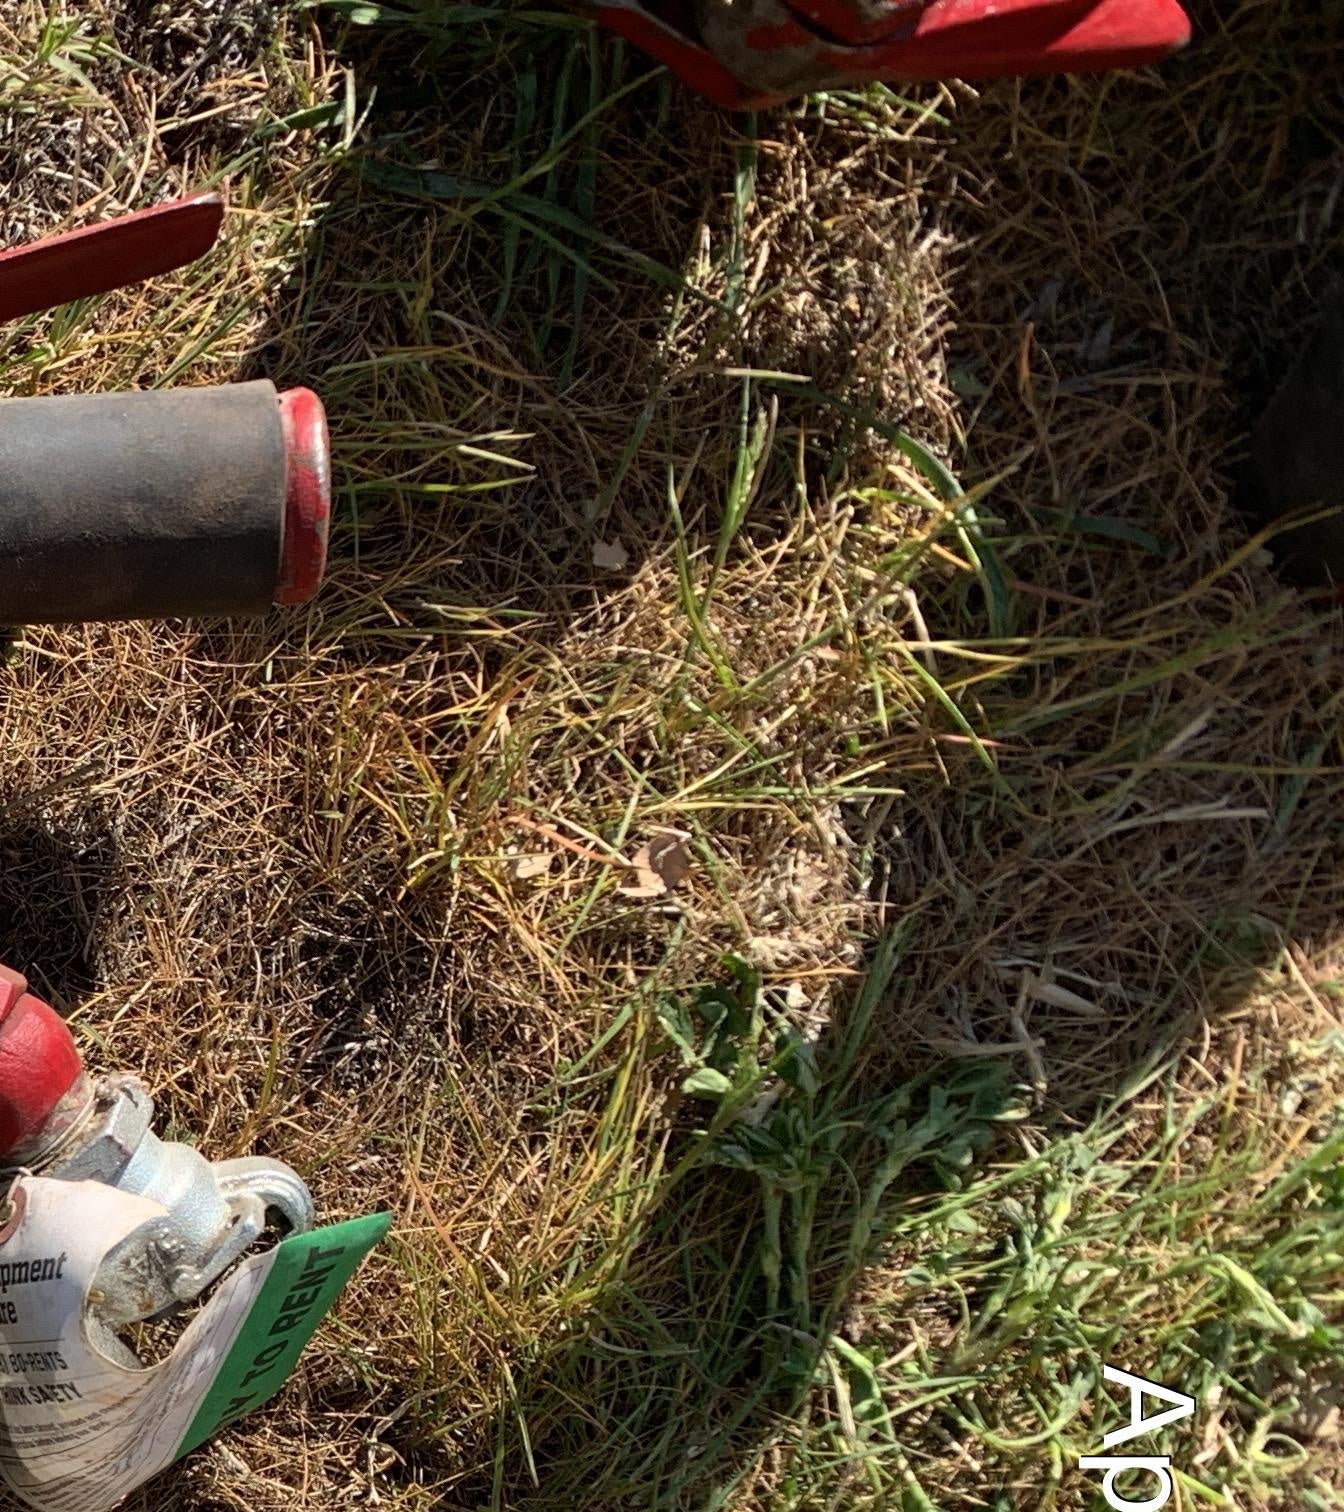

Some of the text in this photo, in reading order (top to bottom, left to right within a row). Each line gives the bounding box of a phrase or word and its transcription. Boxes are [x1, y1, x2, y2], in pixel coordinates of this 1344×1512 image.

[240, 1246, 345, 1388] TO RENT
[29, 1382, 82, 1405] SAFETY
